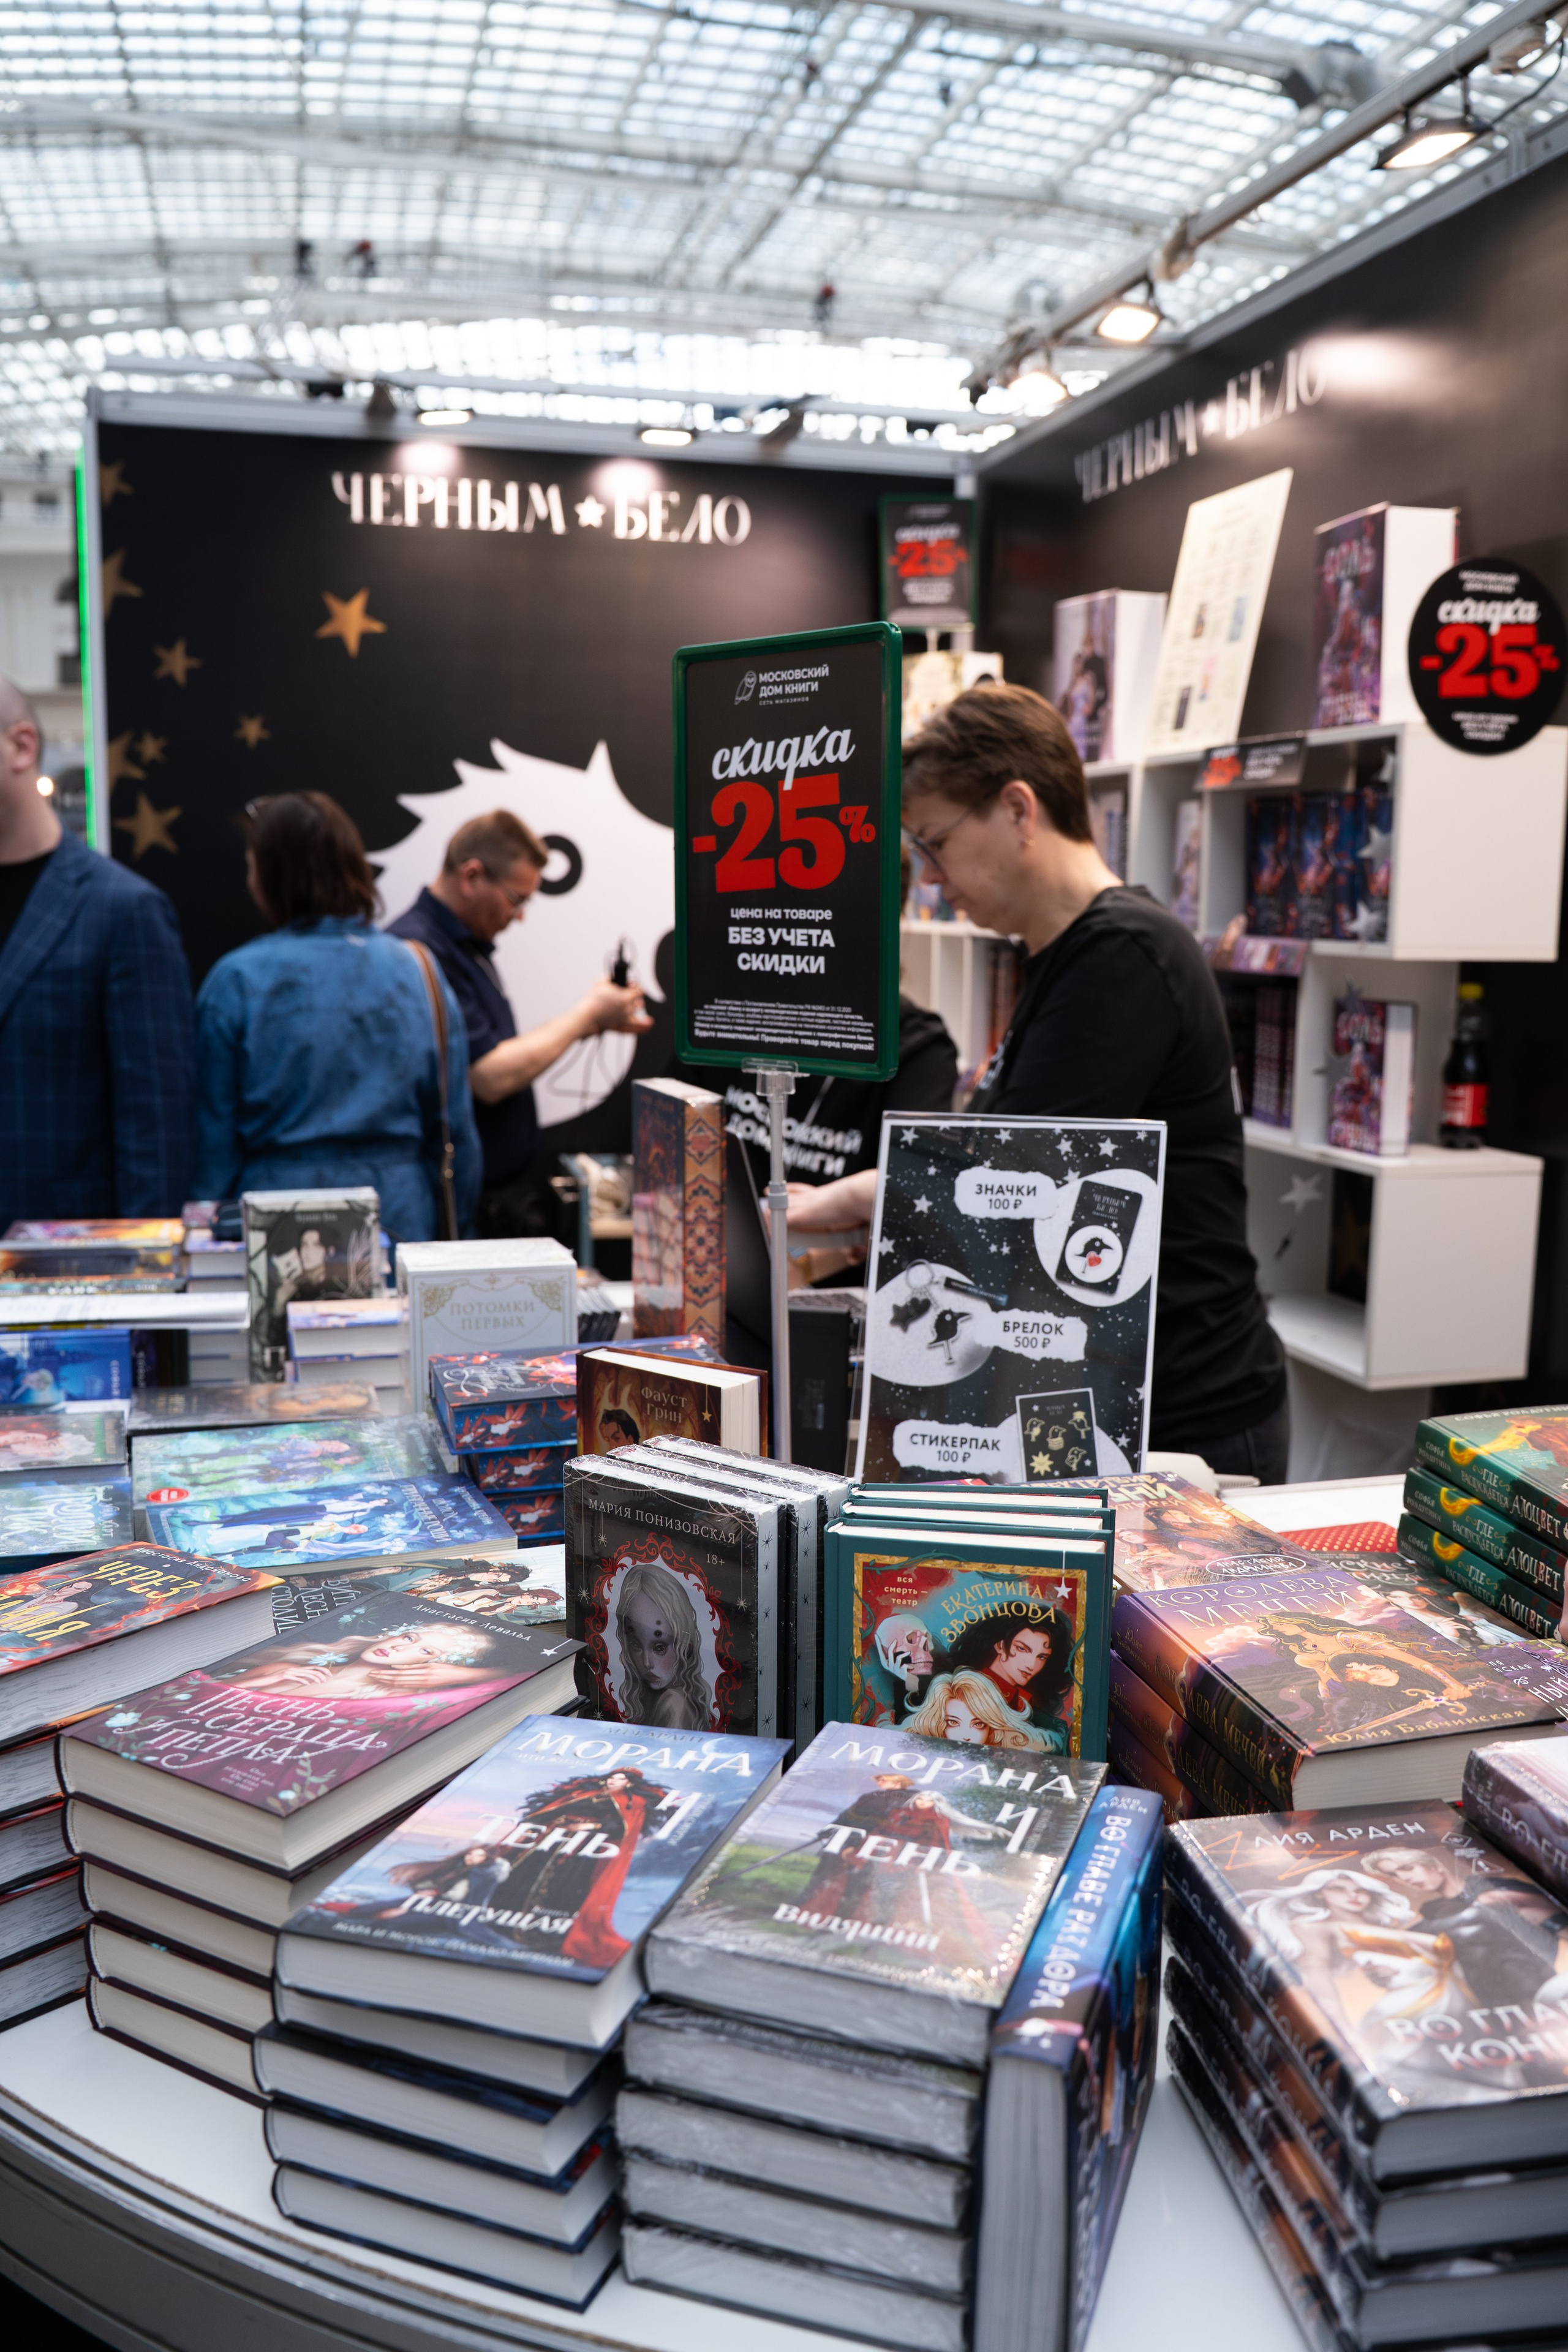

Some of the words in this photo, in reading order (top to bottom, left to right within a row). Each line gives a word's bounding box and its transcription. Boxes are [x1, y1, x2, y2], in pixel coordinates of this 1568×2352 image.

[331, 471, 569, 535] ЧЕРНЫМ
[612, 491, 752, 546] БЕЛО
[758, 664, 829, 683] МОСКОВСКИЙ
[758, 684, 783, 698] ДОМ
[785, 681, 818, 695] КНИГИ
[712, 726, 856, 791] скидка
[693, 773, 876, 893] -25%
[730, 908, 763, 920] цена
[764, 909, 782, 919] на
[783, 909, 833, 922] товаре
[728, 927, 766, 945] БЕЗ
[767, 927, 835, 948] УЧЕТА
[737, 953, 826, 976] СКИДКИ
[975, 1183, 1037, 1197] ЗНАЧКИ
[989, 1199, 1010, 1210] 100
[450, 1300, 535, 1316] ПОТОМКИ
[1003, 1321, 1064, 1335] БРЕЛОК
[1014, 1336, 1038, 1349] 500
[641, 1387, 687, 1408] Фауст
[646, 1403, 682, 1423] Грин
[910, 1433, 1001, 1451] СТИКЕРПАК
[937, 1450, 959, 1463] 100
[1461, 1471, 1509, 1509] РАСПУСКАЕТСЯ
[1482, 1469, 1499, 1487] ГДЕ
[588, 1498, 631, 1520] МАРИЯ
[1510, 1495, 1561, 1539] АЛОЦВЕТ
[635, 1509, 736, 1545] ПОНИЗОВСКАЯ
[1452, 1520, 1504, 1561] РАСПУСКАЕТСЯ
[1476, 1519, 1494, 1539] ГДЕ
[186, 1560, 253, 1583] Андрианова
[706, 1553, 726, 1566] 18+
[1215, 1557, 1285, 1567] АНАСТАСИЯ
[1468, 1566, 1487, 1585] ГДЕ
[1504, 1547, 1561, 1591] АЛОЦВЕТ
[45, 1560, 203, 1599] ЧЕРЕЗ
[1144, 1573, 1352, 1609] КОРОЛЕВА
[294, 1586, 329, 1620] ЛЕСН
[940, 1580, 1043, 1616] ЕКАТЕРИНА
[1171, 1588, 1373, 1632] МЕЧЕЙ
[412, 1604, 478, 1625] Анастасия
[479, 1623, 532, 1642] Левальд
[940, 1600, 1055, 1643] ЗВОНЦОВА
[1498, 1594, 1551, 1638] АЛОЦВЕТ
[179, 1687, 341, 1721] ПЕСНЬ
[1155, 1655, 1218, 1735] КОРОЛЕВА
[205, 1713, 388, 1753] СЕРДЦА
[1325, 1728, 1392, 1744] Юлия
[1396, 1710, 1526, 1734] Бабчинская
[146, 1726, 299, 1769] ПЕПЛА
[516, 1731, 753, 1776] МОРАНА
[1223, 1717, 1266, 1777] МЕЧЕЙ
[829, 1740, 1078, 1800] МОРАНА
[654, 1789, 703, 1839] И
[995, 1802, 1039, 1855] И
[1099, 1815, 1132, 1842] ВО
[471, 1813, 620, 1860] ТЕНЬ
[818, 1823, 981, 1877] ТЕНЬ
[1255, 1831, 1315, 1849] ЛИЯ
[1329, 1822, 1427, 1842] АРДЕН
[1385, 2013, 1464, 2043] ВО
